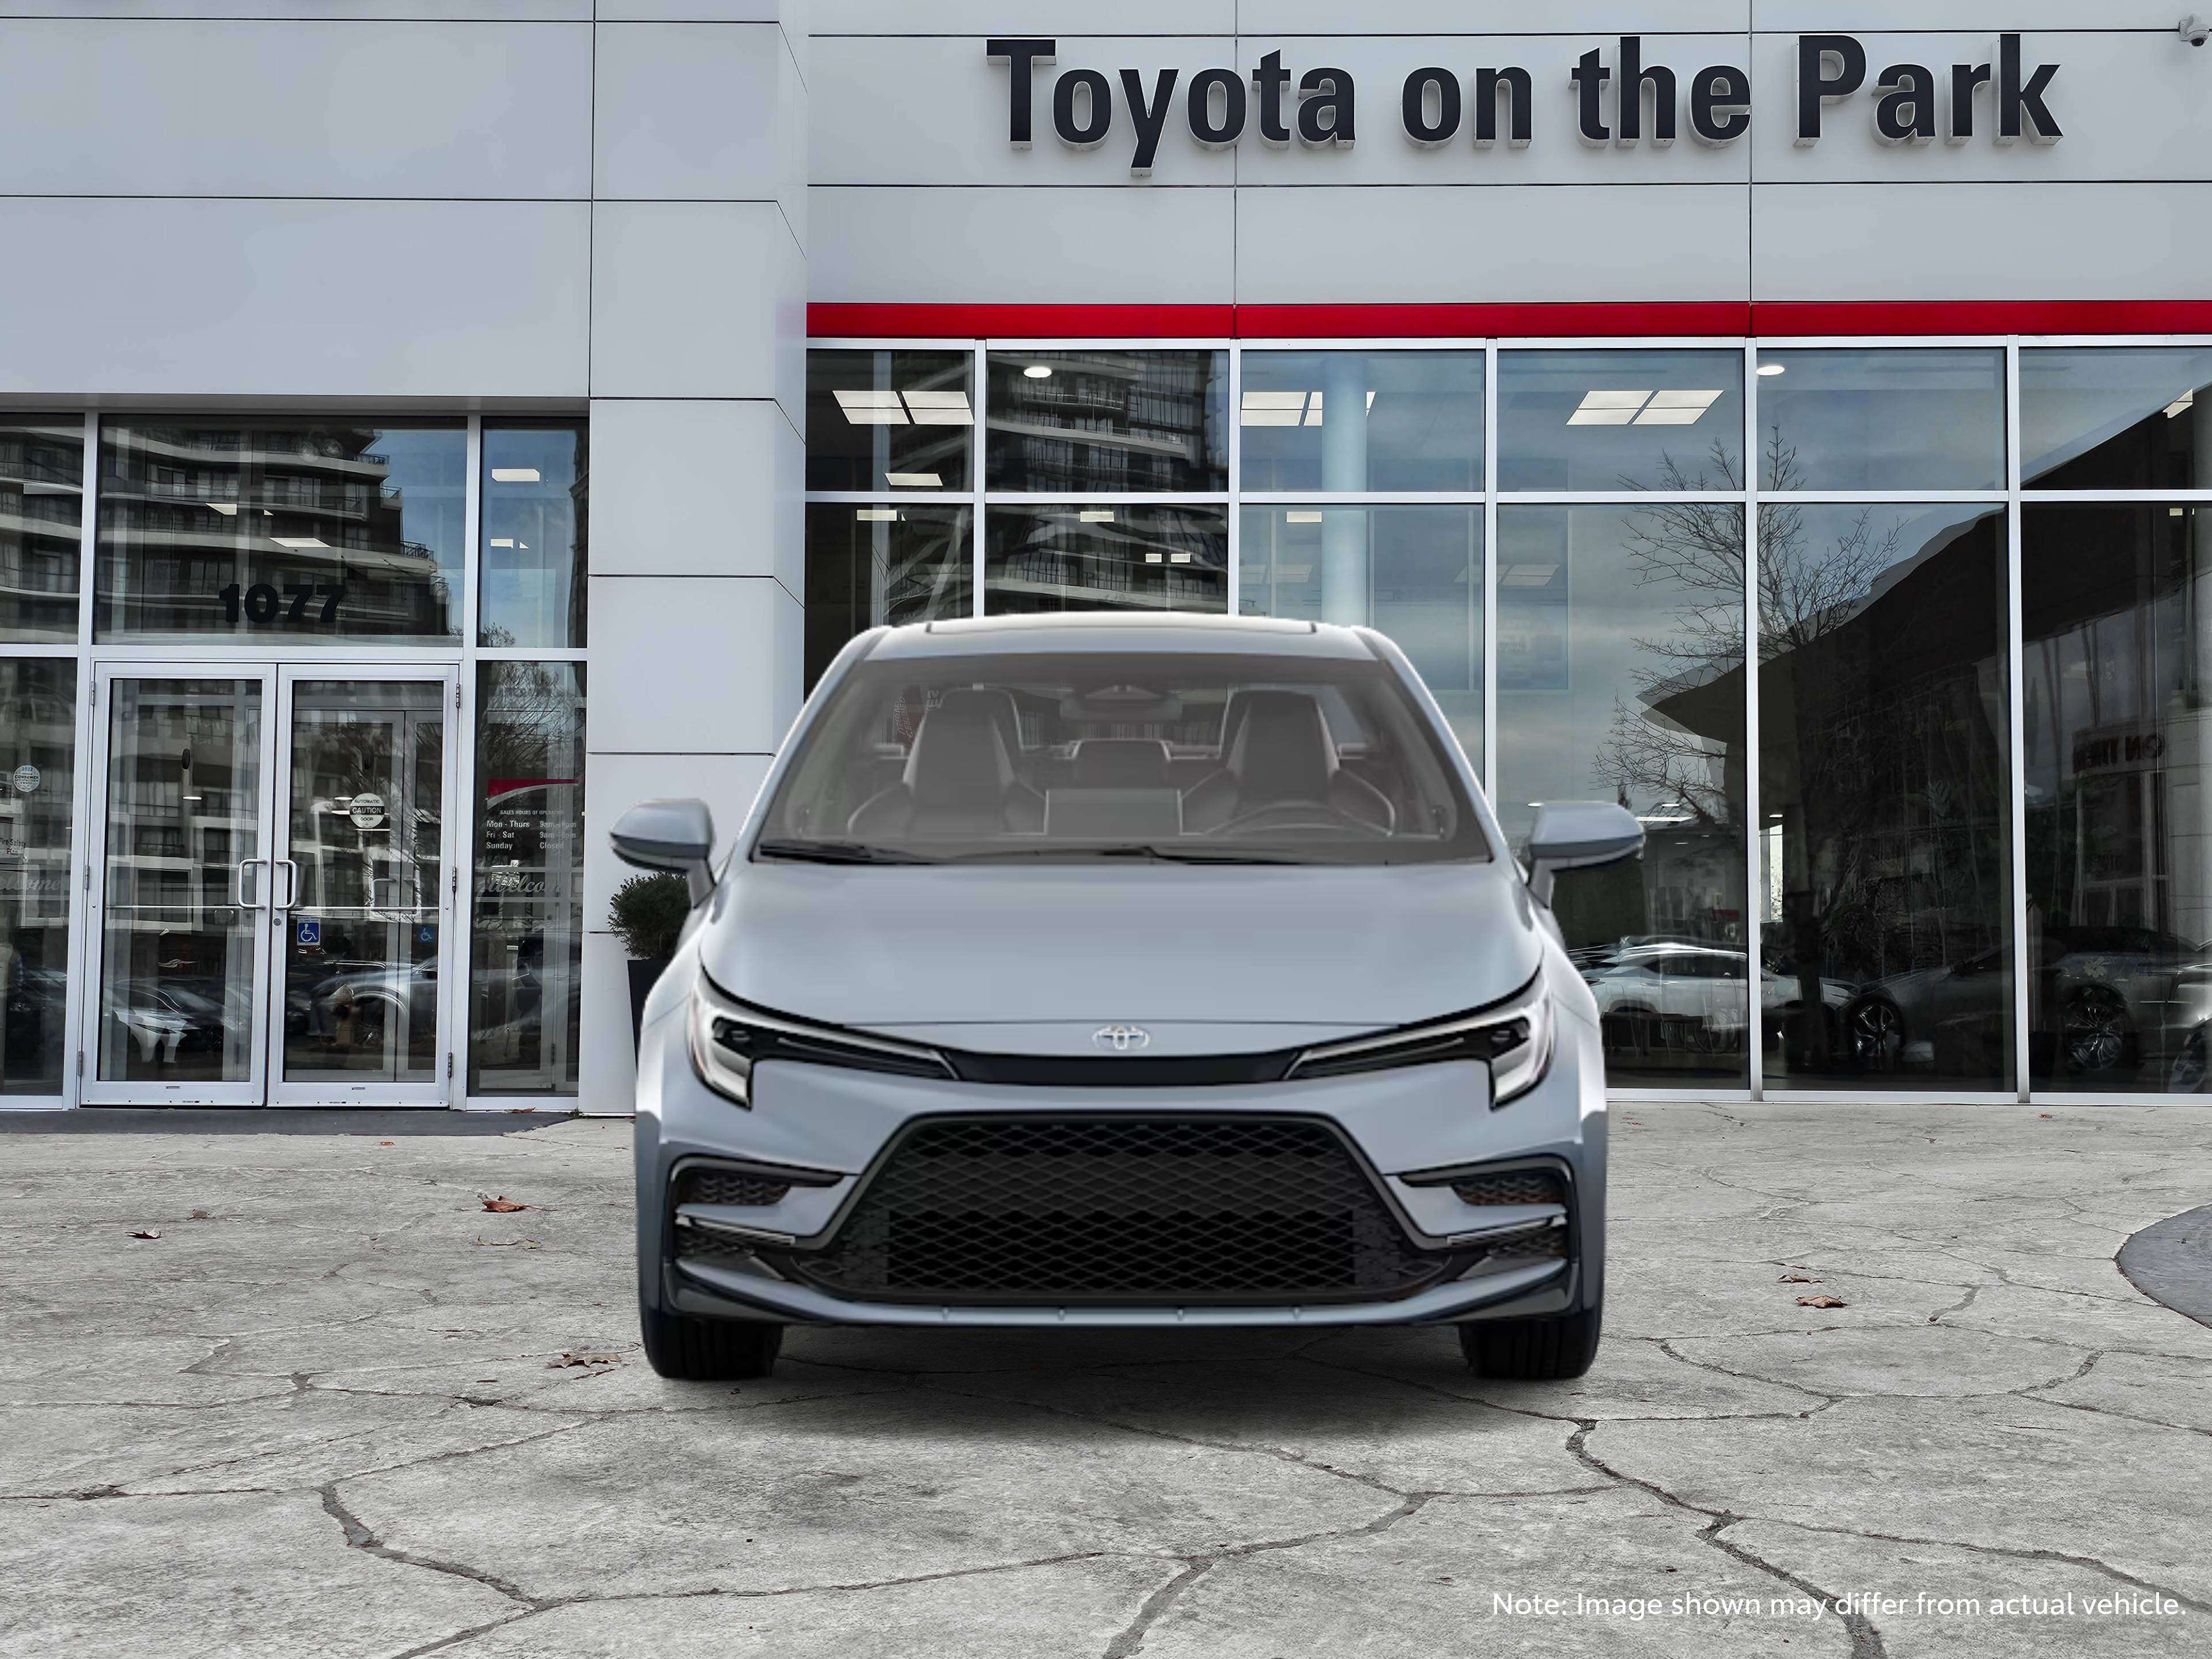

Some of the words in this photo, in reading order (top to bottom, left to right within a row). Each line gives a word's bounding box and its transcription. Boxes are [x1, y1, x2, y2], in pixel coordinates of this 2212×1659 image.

[984, 39, 1356, 176] Toyota
[1400, 65, 1532, 149] on
[1568, 35, 1751, 148] the
[1793, 32, 2064, 147] Park
[218, 583, 348, 623] 1077
[486, 842, 513, 850] Sunday
[539, 842, 564, 850] Closed
